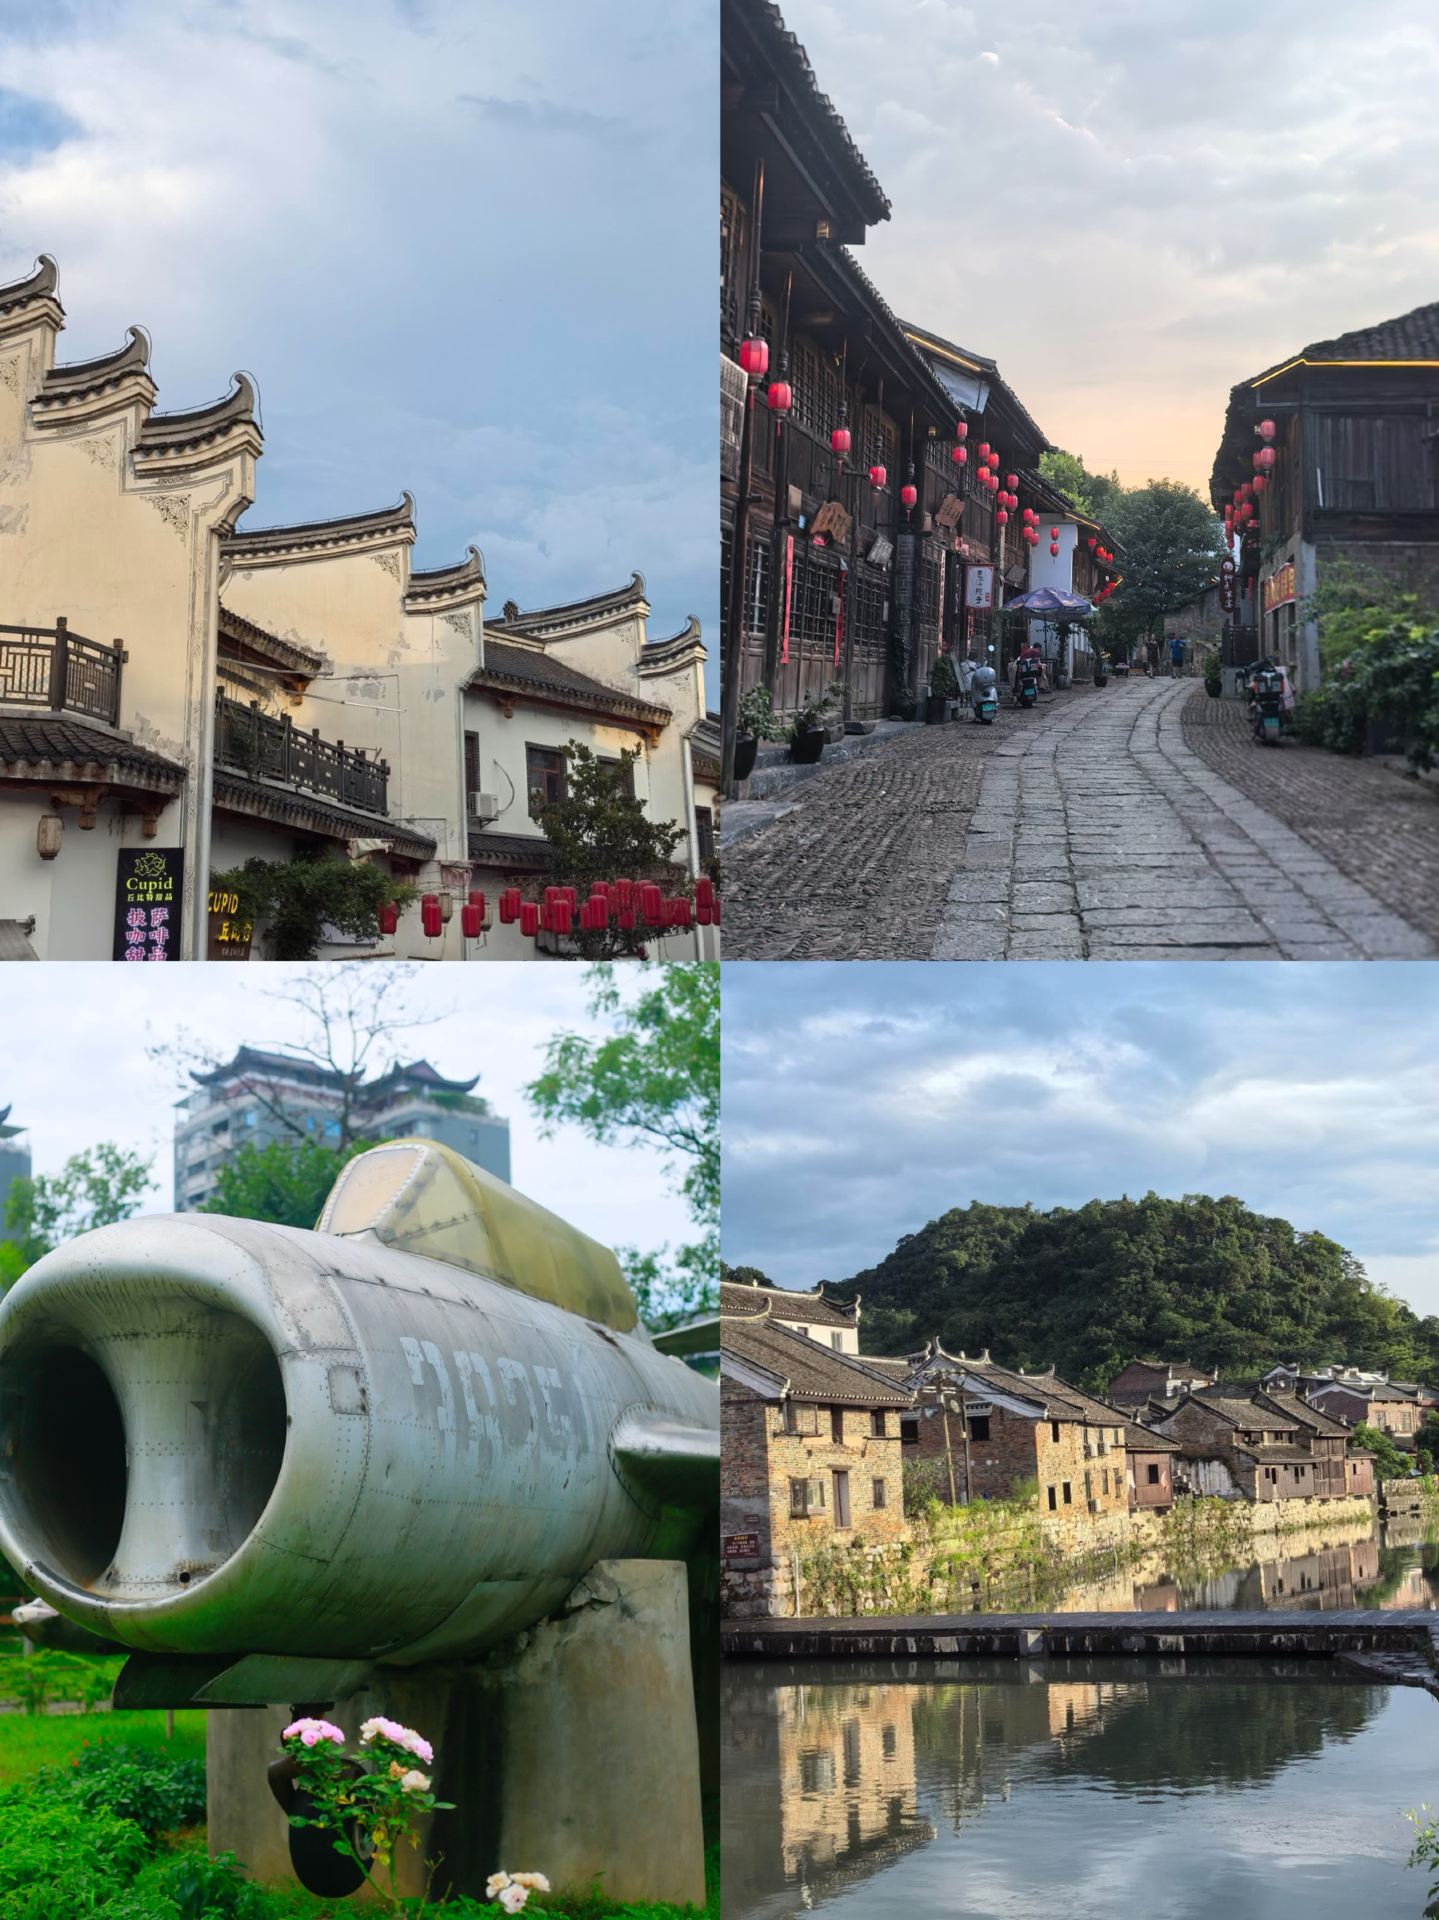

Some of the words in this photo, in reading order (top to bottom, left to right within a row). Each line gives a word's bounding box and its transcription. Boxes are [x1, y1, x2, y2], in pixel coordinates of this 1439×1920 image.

[126, 877, 173, 893] Cupid
[127, 893, 172, 902] 丘比特甜品
[126, 907, 170, 927] 披萨
[125, 926, 170, 945] 咖啡
